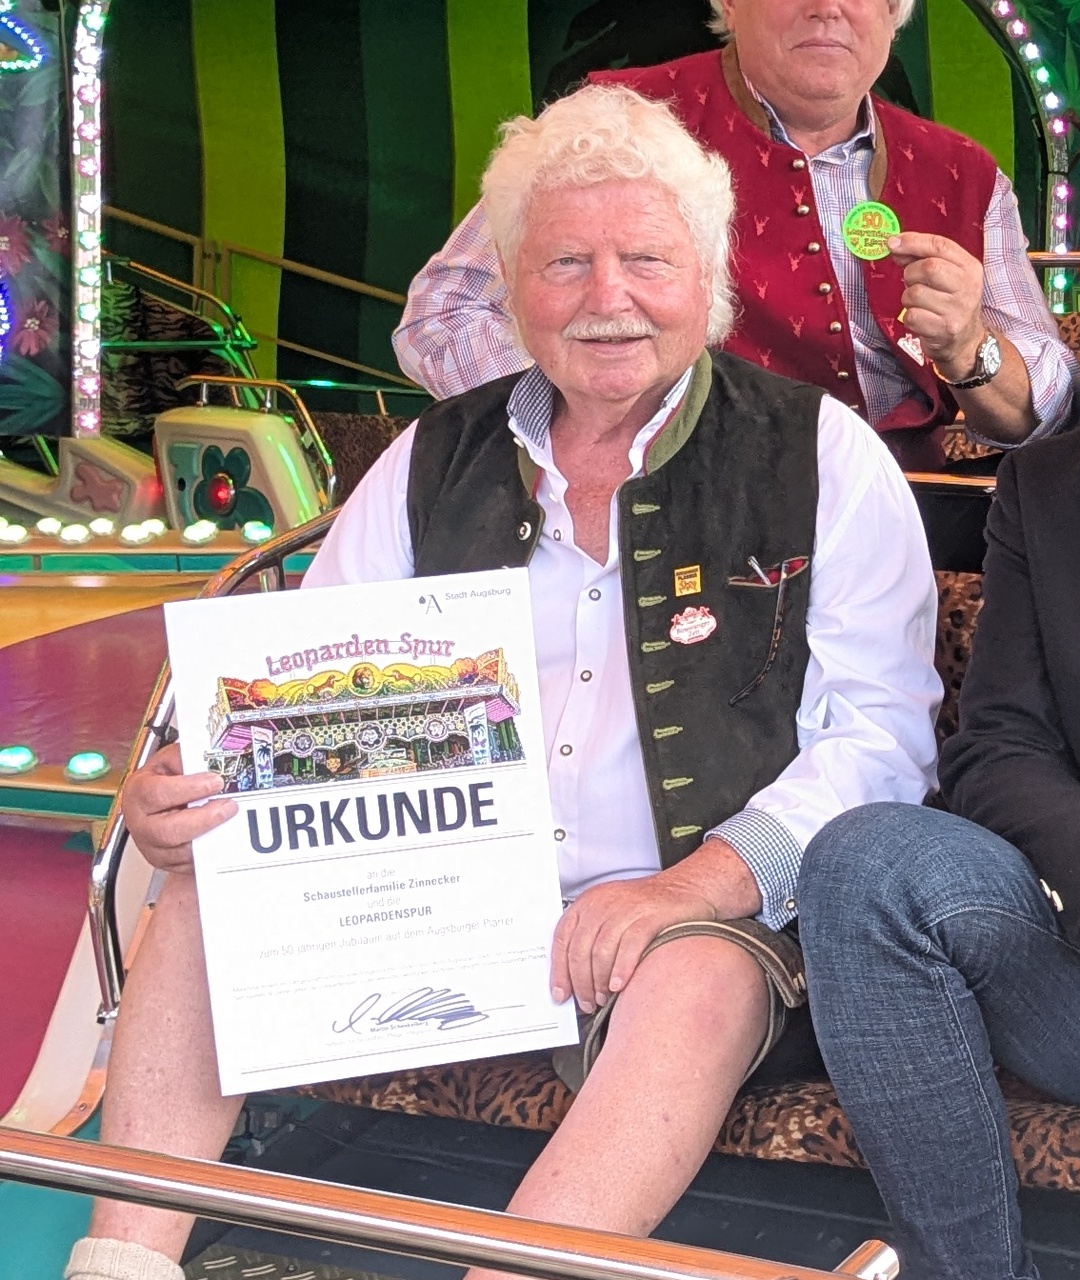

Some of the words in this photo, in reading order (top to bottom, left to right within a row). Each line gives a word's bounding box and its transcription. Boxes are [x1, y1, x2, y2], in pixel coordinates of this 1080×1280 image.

[862, 211, 883, 229] 50
[445, 591, 468, 601] Stadt
[470, 587, 512, 598] Augsburg
[265, 633, 391, 677] Leoparden
[399, 631, 456, 660] Spur
[247, 781, 498, 854] URKUNDE
[366, 871, 378, 880] an
[381, 868, 396, 878] die
[303, 881, 406, 903] Schaustellerfamilie
[408, 874, 461, 889] Zinnecker
[367, 897, 385, 909] und
[387, 896, 401, 906] die
[339, 905, 433, 927] LEOPARDENSPUR
